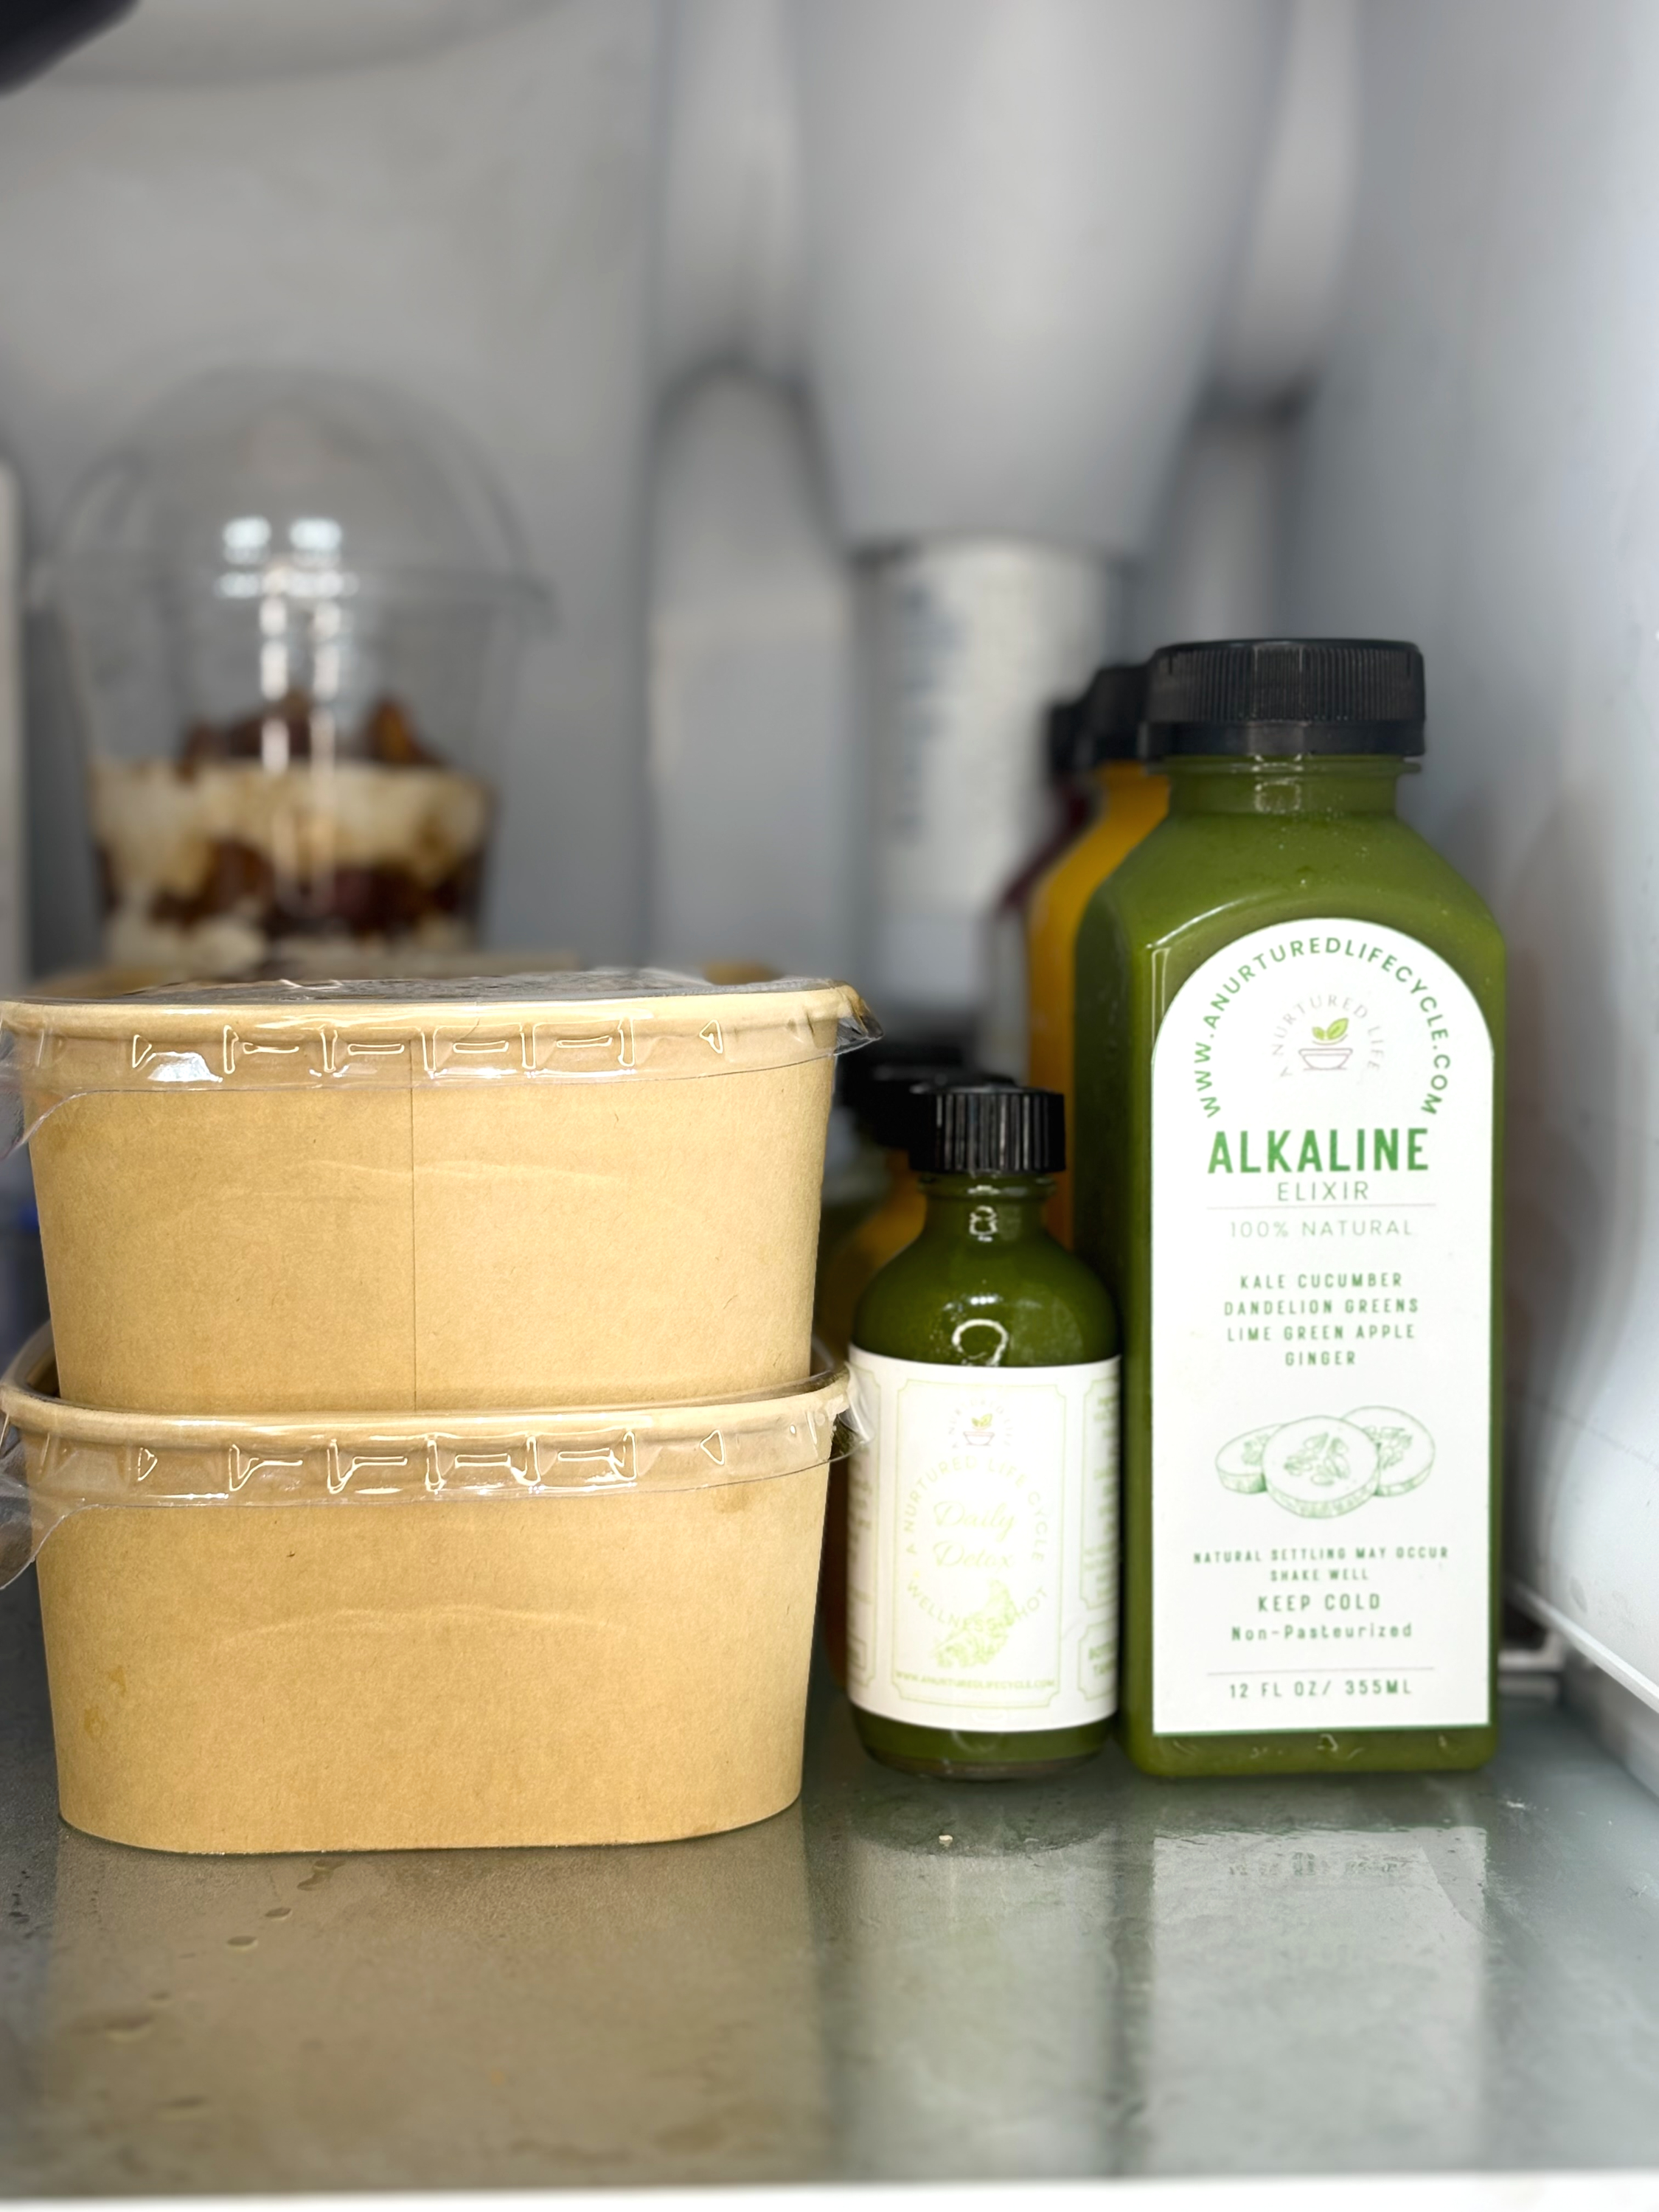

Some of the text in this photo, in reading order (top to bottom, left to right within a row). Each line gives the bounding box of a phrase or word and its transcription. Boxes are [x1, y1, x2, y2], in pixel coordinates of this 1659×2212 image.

[1194, 937, 1451, 1118] WWW.ANURTUREDLIFECYCLE.COM
[1271, 994, 1368, 1056] NURTURED
[1207, 1127, 1428, 1174] ALKALINE
[1277, 1180, 1369, 1202] ELIXIR
[1229, 1219, 1413, 1239] 100% NATURAL
[1239, 1272, 1403, 1290] KALE CUCUMBER
[1224, 1297, 1419, 1316] DANDELION GREENS
[1227, 1324, 1416, 1342] LIME GREEN APPLE
[1284, 1351, 1357, 1366] GINGER
[903, 1455, 978, 1533] NURTURED
[987, 1457, 1028, 1489] LIFE
[1027, 1490, 1048, 1562] CYCLE
[933, 1500, 1017, 1543] Daily
[932, 1540, 1015, 1571] Detox
[1193, 1546, 1450, 1564] NATURAL SETTLING MAY OCCUR
[1270, 1568, 1369, 1582] SHAKE WELL
[1258, 1593, 1382, 1613] KEEP COLD
[1231, 1623, 1413, 1641] Non-Pasteurized
[1229, 1679, 1412, 1698] 12 FL OZ/ 355ML
